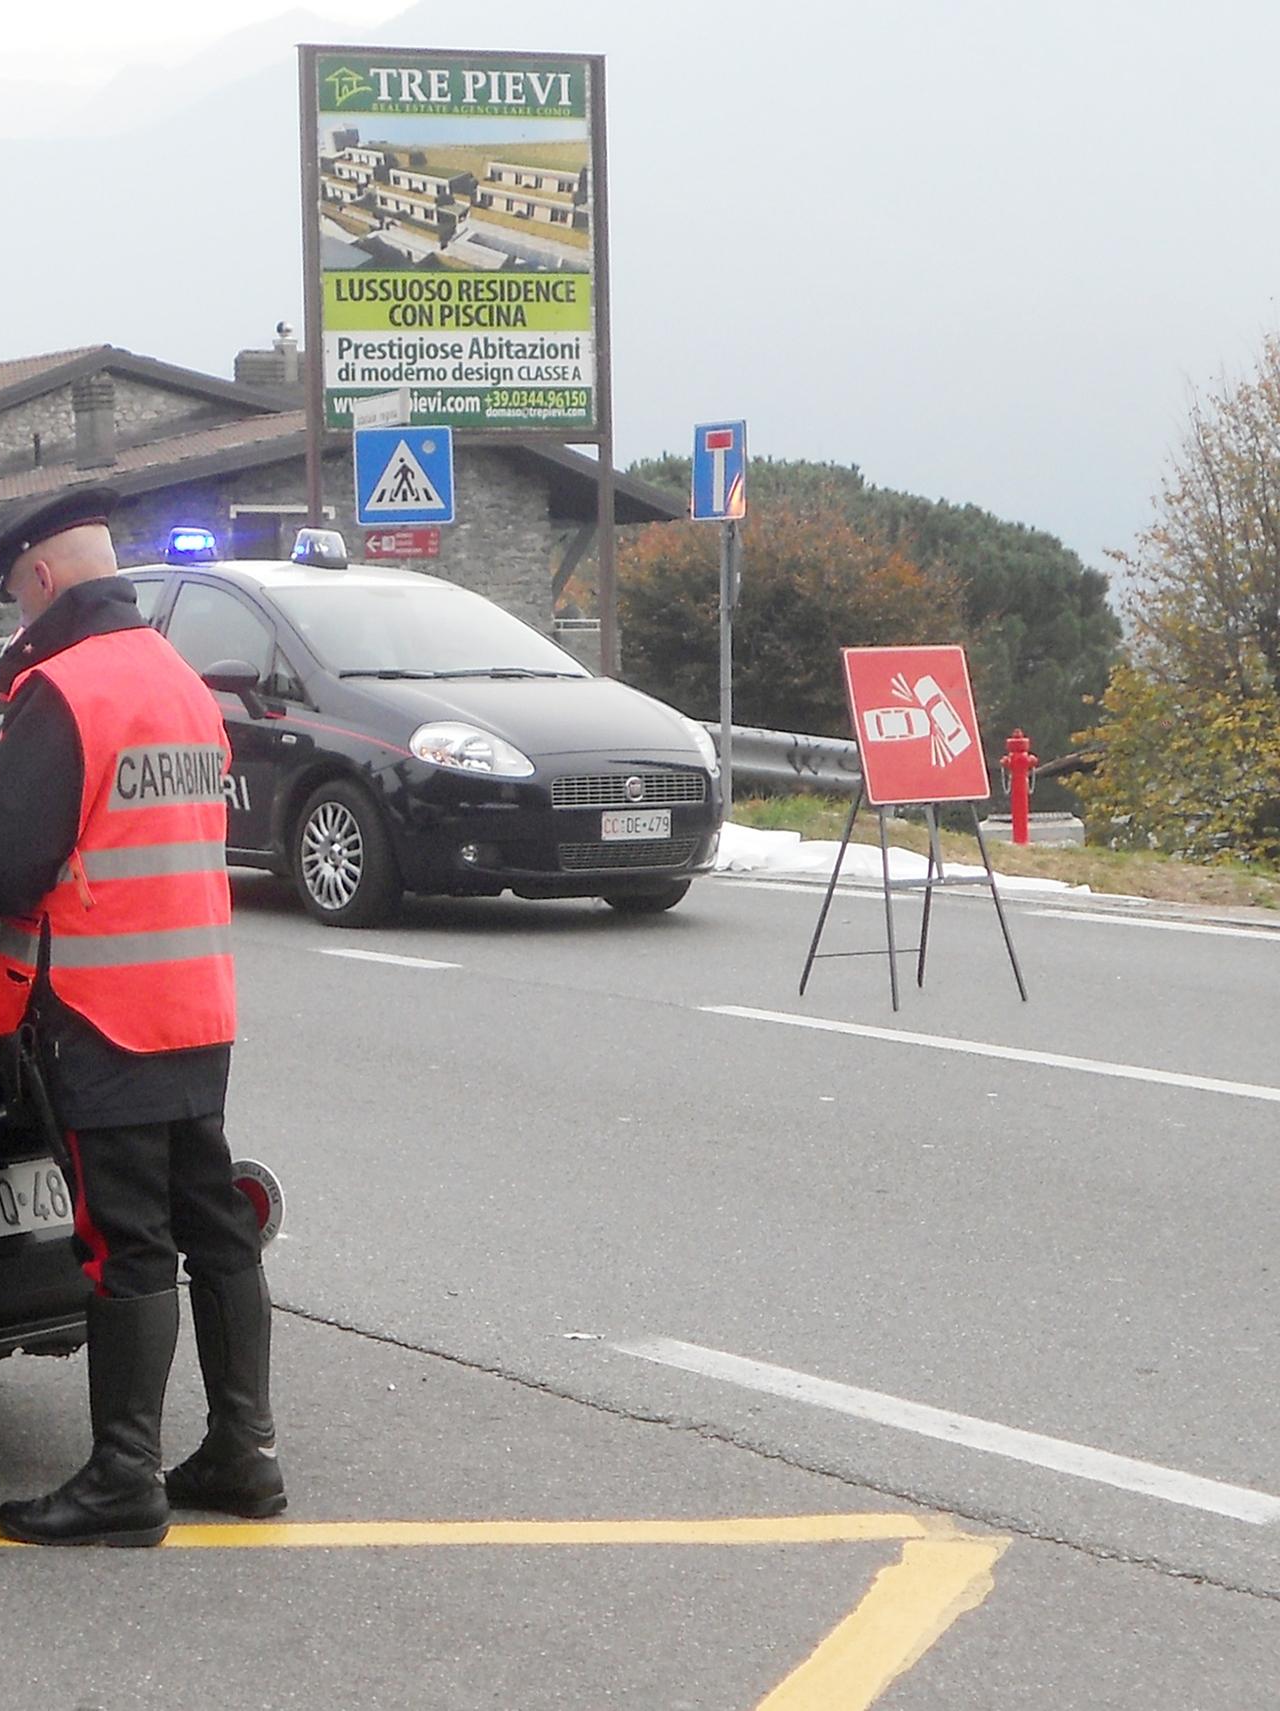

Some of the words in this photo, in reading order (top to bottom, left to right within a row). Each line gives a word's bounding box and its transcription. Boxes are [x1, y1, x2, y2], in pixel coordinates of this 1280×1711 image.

[369, 67, 452, 102] TRE
[461, 69, 572, 106] PIEVI
[452, 104, 499, 115] AGENCY
[335, 278, 453, 303] LUSSUOSO
[458, 279, 577, 303] RESIDENCE
[389, 304, 434, 327] CON
[439, 304, 528, 327] PISCINA
[337, 337, 463, 366] Prestigiose
[468, 337, 581, 360] Abitazioni
[337, 362, 355, 382] di
[361, 363, 447, 381] moderno
[452, 362, 514, 386] design
[517, 366, 571, 382] CLASSE
[572, 367, 581, 381] A
